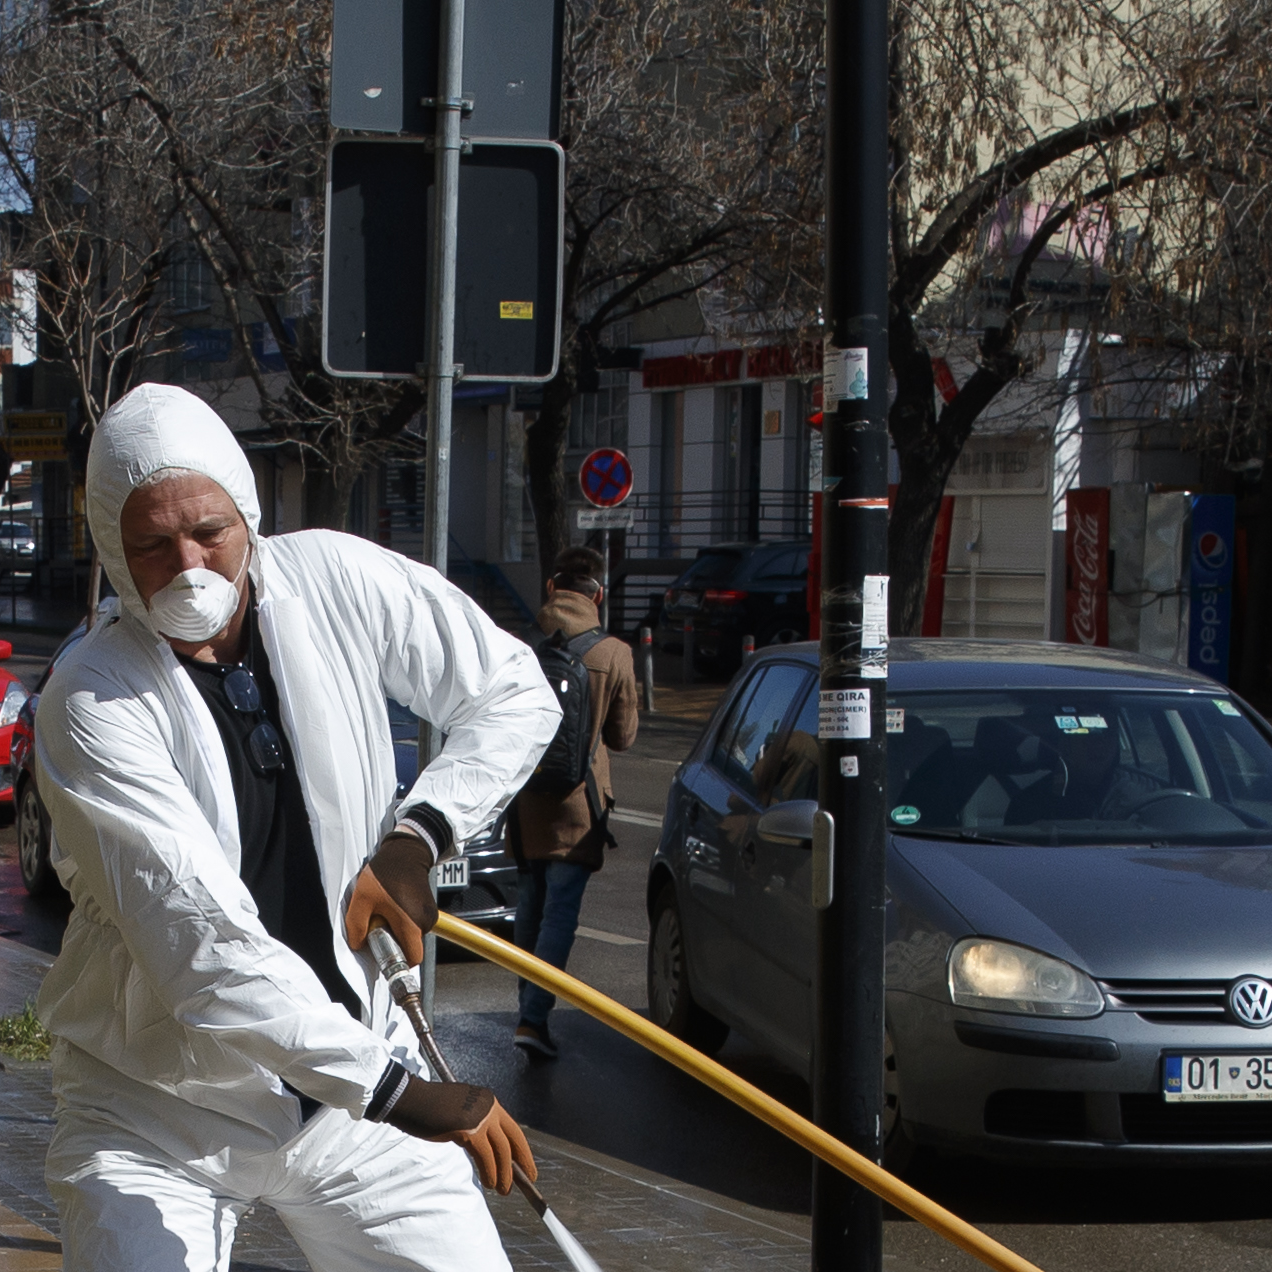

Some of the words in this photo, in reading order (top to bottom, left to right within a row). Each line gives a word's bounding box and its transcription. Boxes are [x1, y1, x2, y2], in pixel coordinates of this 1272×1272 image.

[1197, 578, 1224, 664] pepsi
[836, 692, 865, 702] QIRA
[1188, 1056, 1221, 1090] 01
